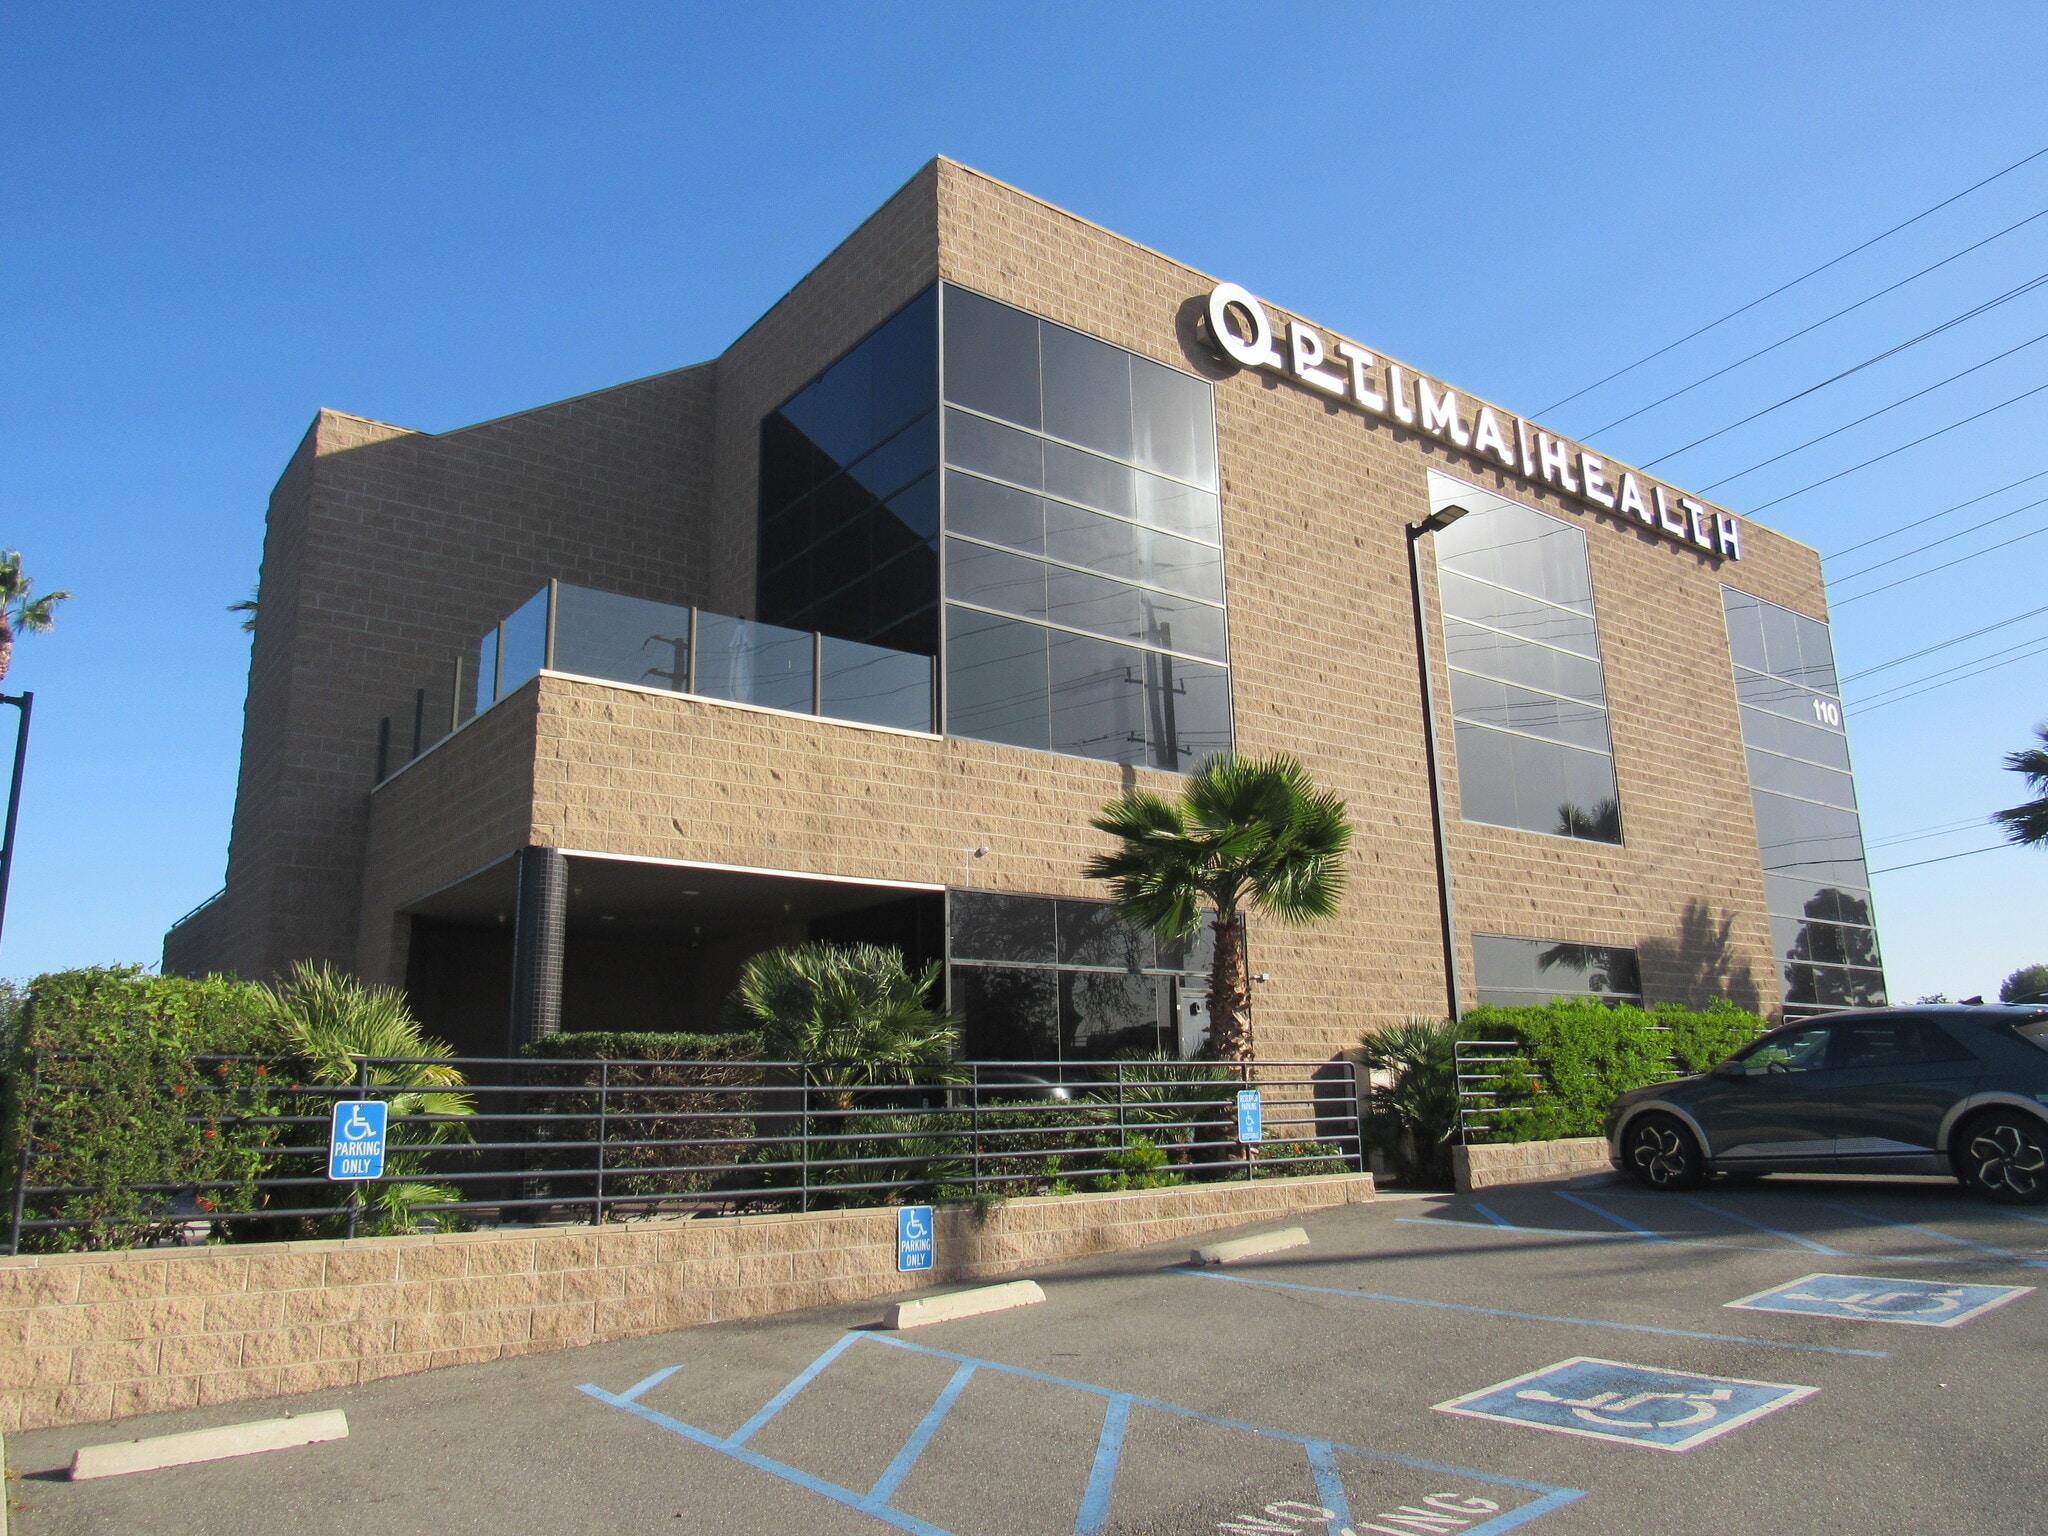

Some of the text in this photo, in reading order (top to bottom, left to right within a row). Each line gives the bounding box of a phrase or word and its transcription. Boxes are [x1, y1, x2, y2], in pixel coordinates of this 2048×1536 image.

[1812, 699, 1838, 727] 110
[335, 1141, 380, 1156] PARKING
[342, 1159, 371, 1174] ONLY
[901, 1239, 931, 1252] PARKING
[906, 1253, 926, 1266] ONLY
